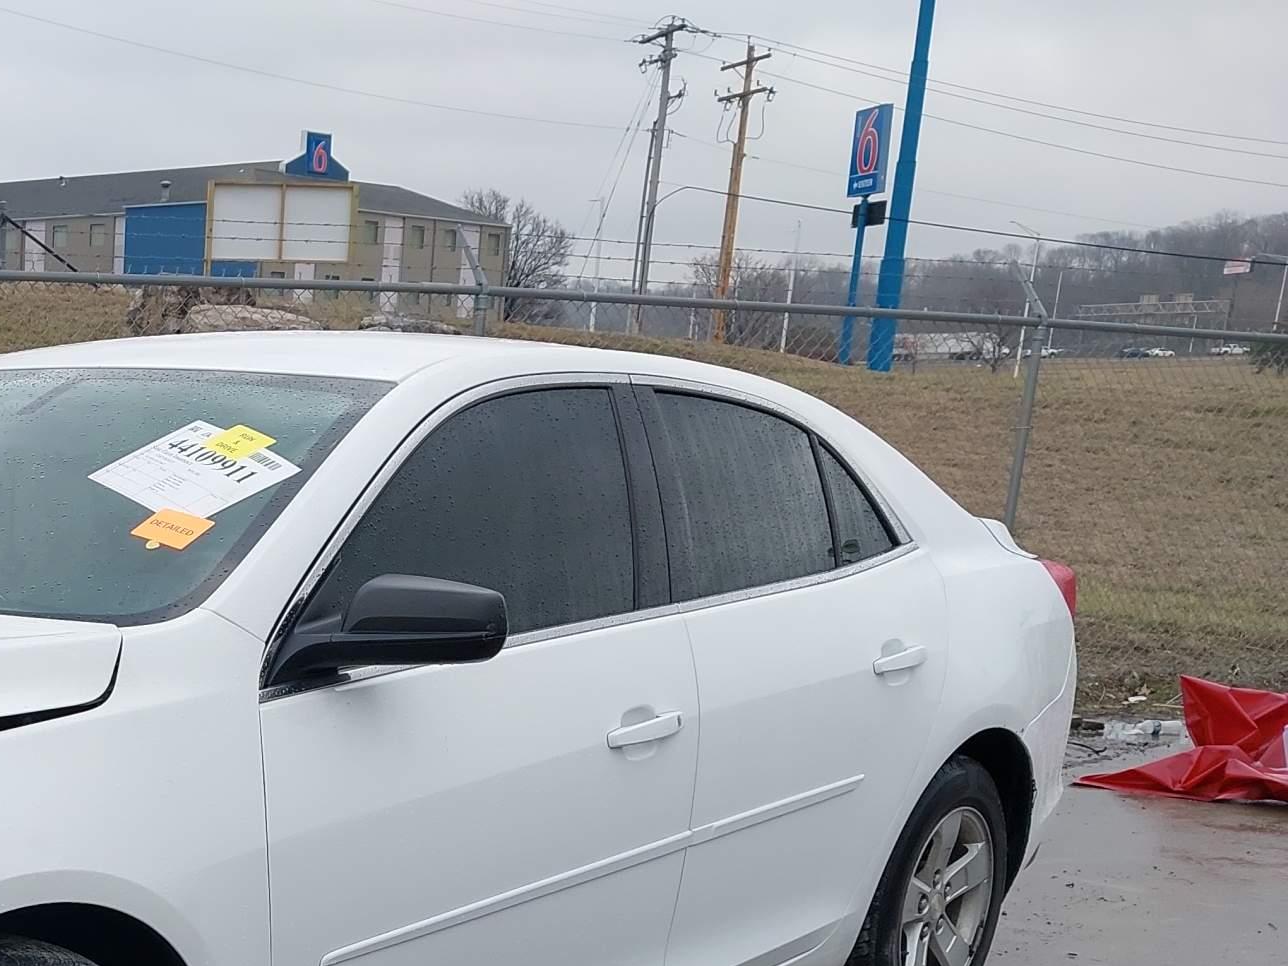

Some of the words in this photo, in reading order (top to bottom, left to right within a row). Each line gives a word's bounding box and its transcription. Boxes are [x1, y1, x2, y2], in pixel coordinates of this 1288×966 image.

[313, 140, 327, 173] 6
[856, 109, 879, 175] 6
[168, 438, 258, 484] 44109911
[215, 441, 239, 454] DRIVE
[150, 518, 195, 537] DETAILED
